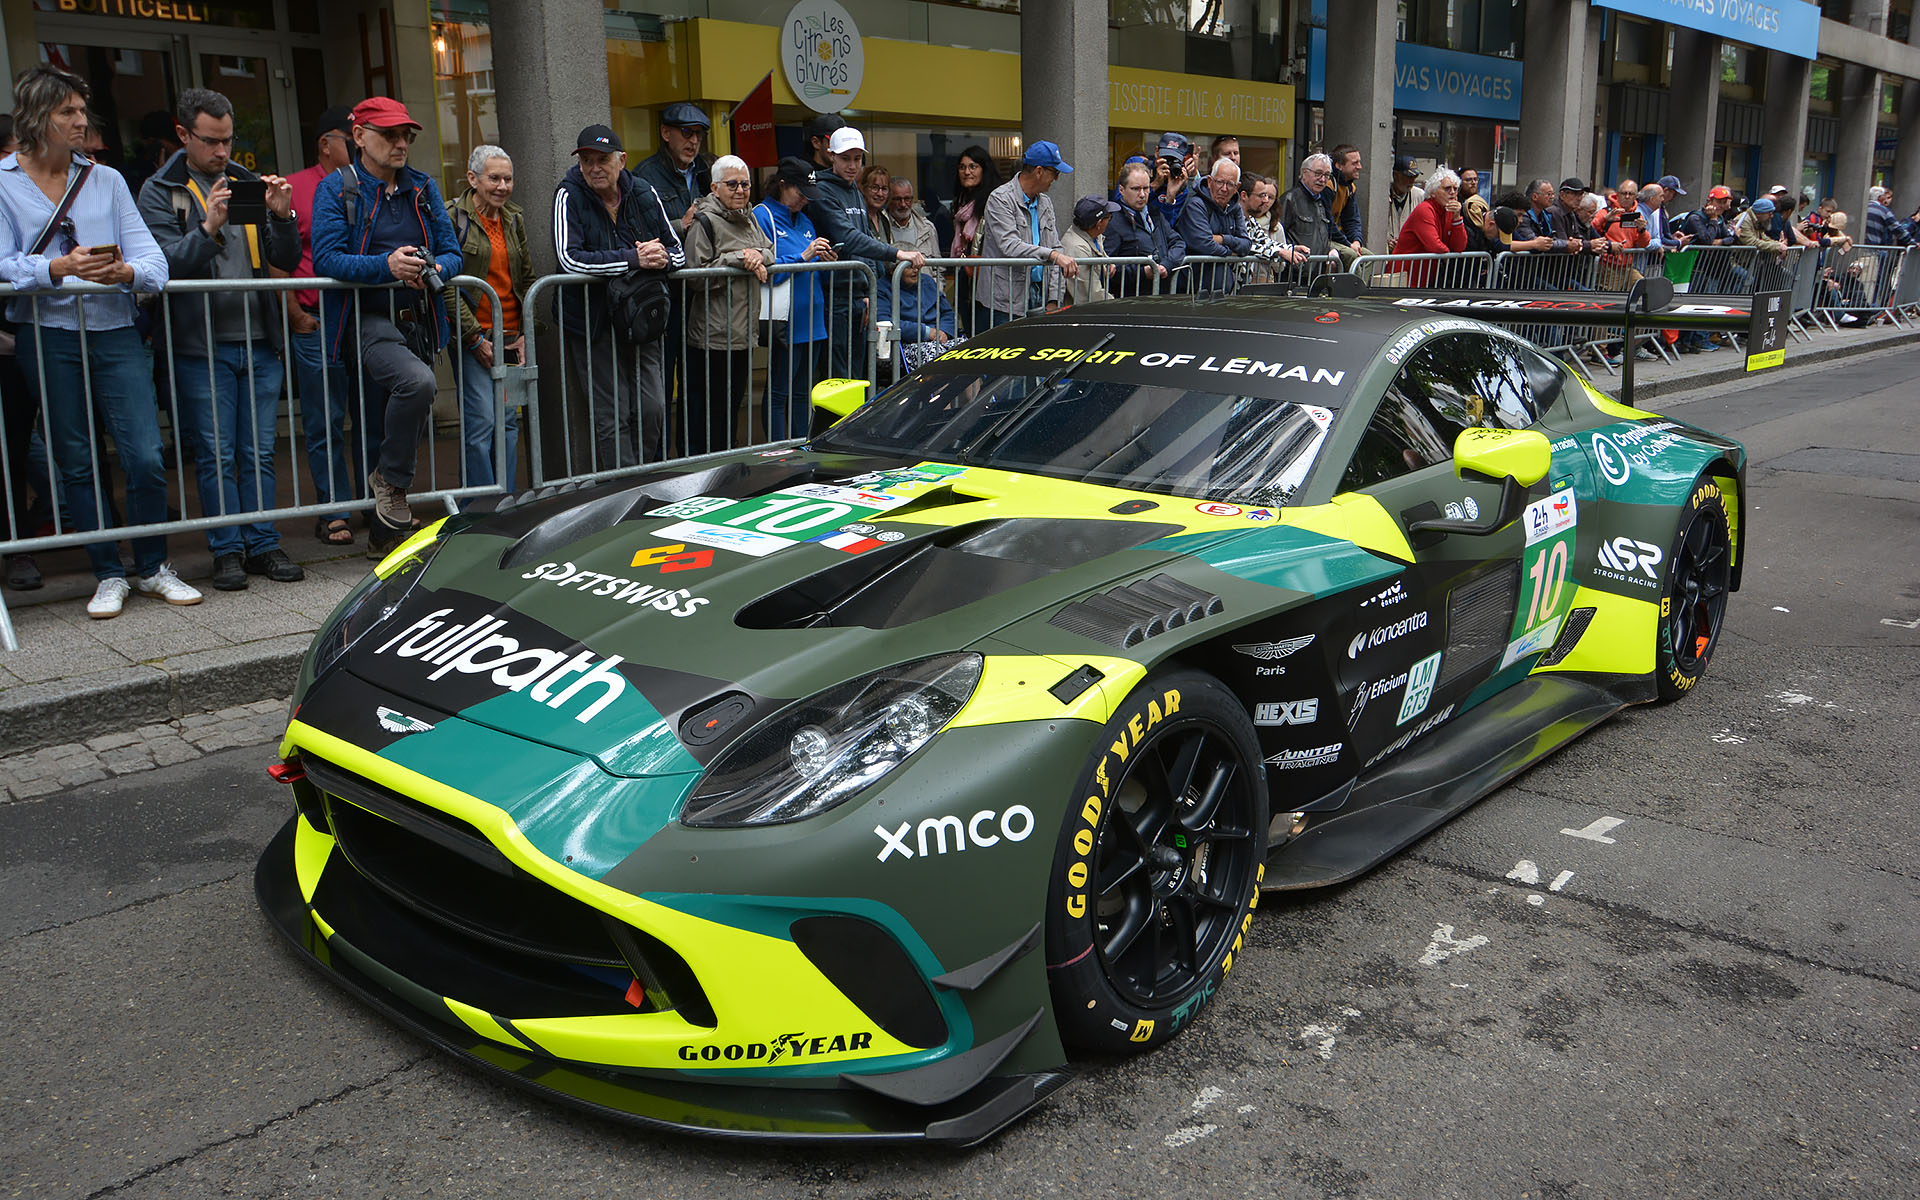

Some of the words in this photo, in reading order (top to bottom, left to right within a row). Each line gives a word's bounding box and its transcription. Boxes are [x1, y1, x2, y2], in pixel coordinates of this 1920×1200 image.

[823, 10, 844, 34] Les
[1435, 67, 1513, 100] VOYAGES
[1177, 89, 1209, 118] FINE
[1214, 93, 1225, 118] &
[1230, 94, 1287, 124] ATELIERS
[934, 347, 1024, 362] RACING
[1029, 348, 1135, 365] SPIRIT
[1139, 352, 1196, 369] OF
[1629, 452, 1651, 465] by
[723, 499, 853, 534] 10
[522, 561, 711, 618] SOFTSWISS
[1525, 540, 1568, 631] 10
[1593, 567, 1625, 581] STRONG
[1627, 576, 1657, 589] RACING
[1368, 611, 1428, 649] Koncentra
[374, 608, 626, 725] fullpath
[1256, 665, 1286, 676] Paris
[1411, 658, 1435, 692] LM
[1370, 672, 1408, 700] Eficium
[1256, 699, 1317, 725] HEXIS
[1401, 687, 1430, 720] GT3
[874, 805, 1035, 863] xmco
